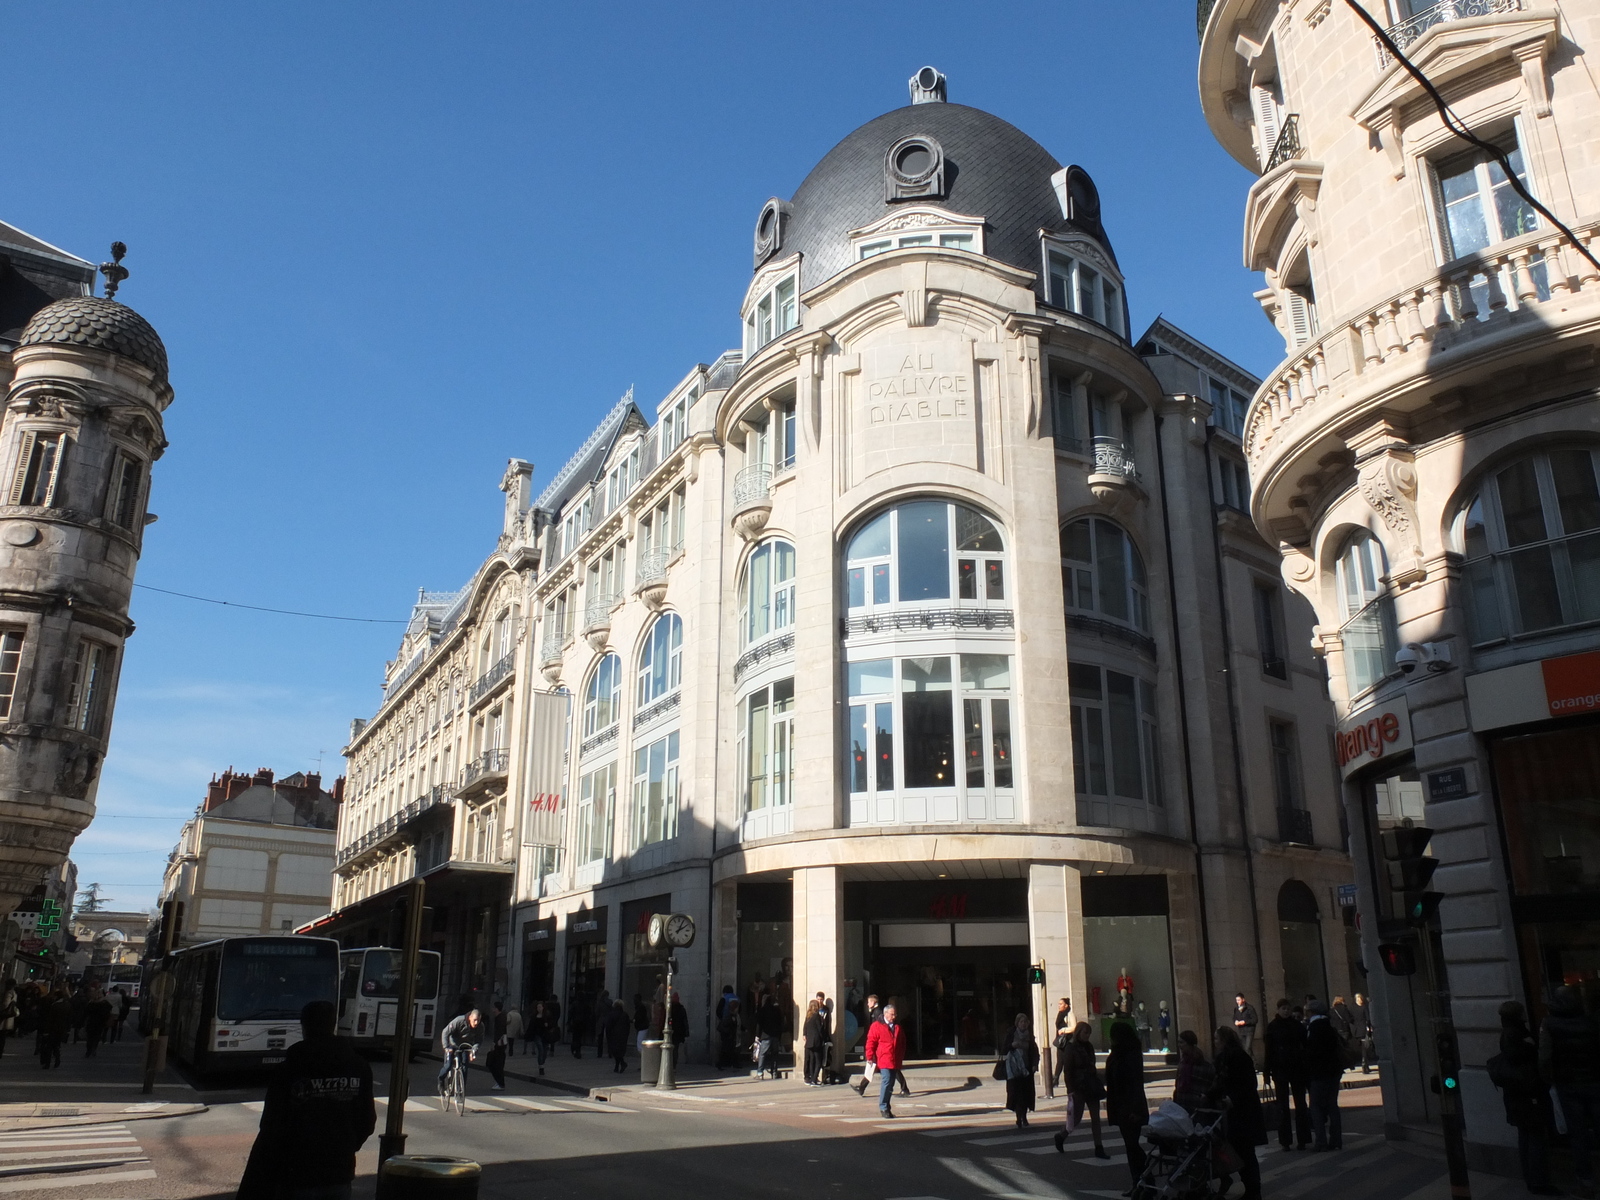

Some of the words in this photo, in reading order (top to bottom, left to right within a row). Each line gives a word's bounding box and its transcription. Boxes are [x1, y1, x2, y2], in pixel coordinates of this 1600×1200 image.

[899, 353, 934, 373] AU
[869, 375, 968, 401] PAUVRE
[870, 399, 968, 424] DIABLE
[1551, 693, 1600, 710] orange
[1438, 774, 1453, 783] RUE
[530, 792, 560, 814] H&M
